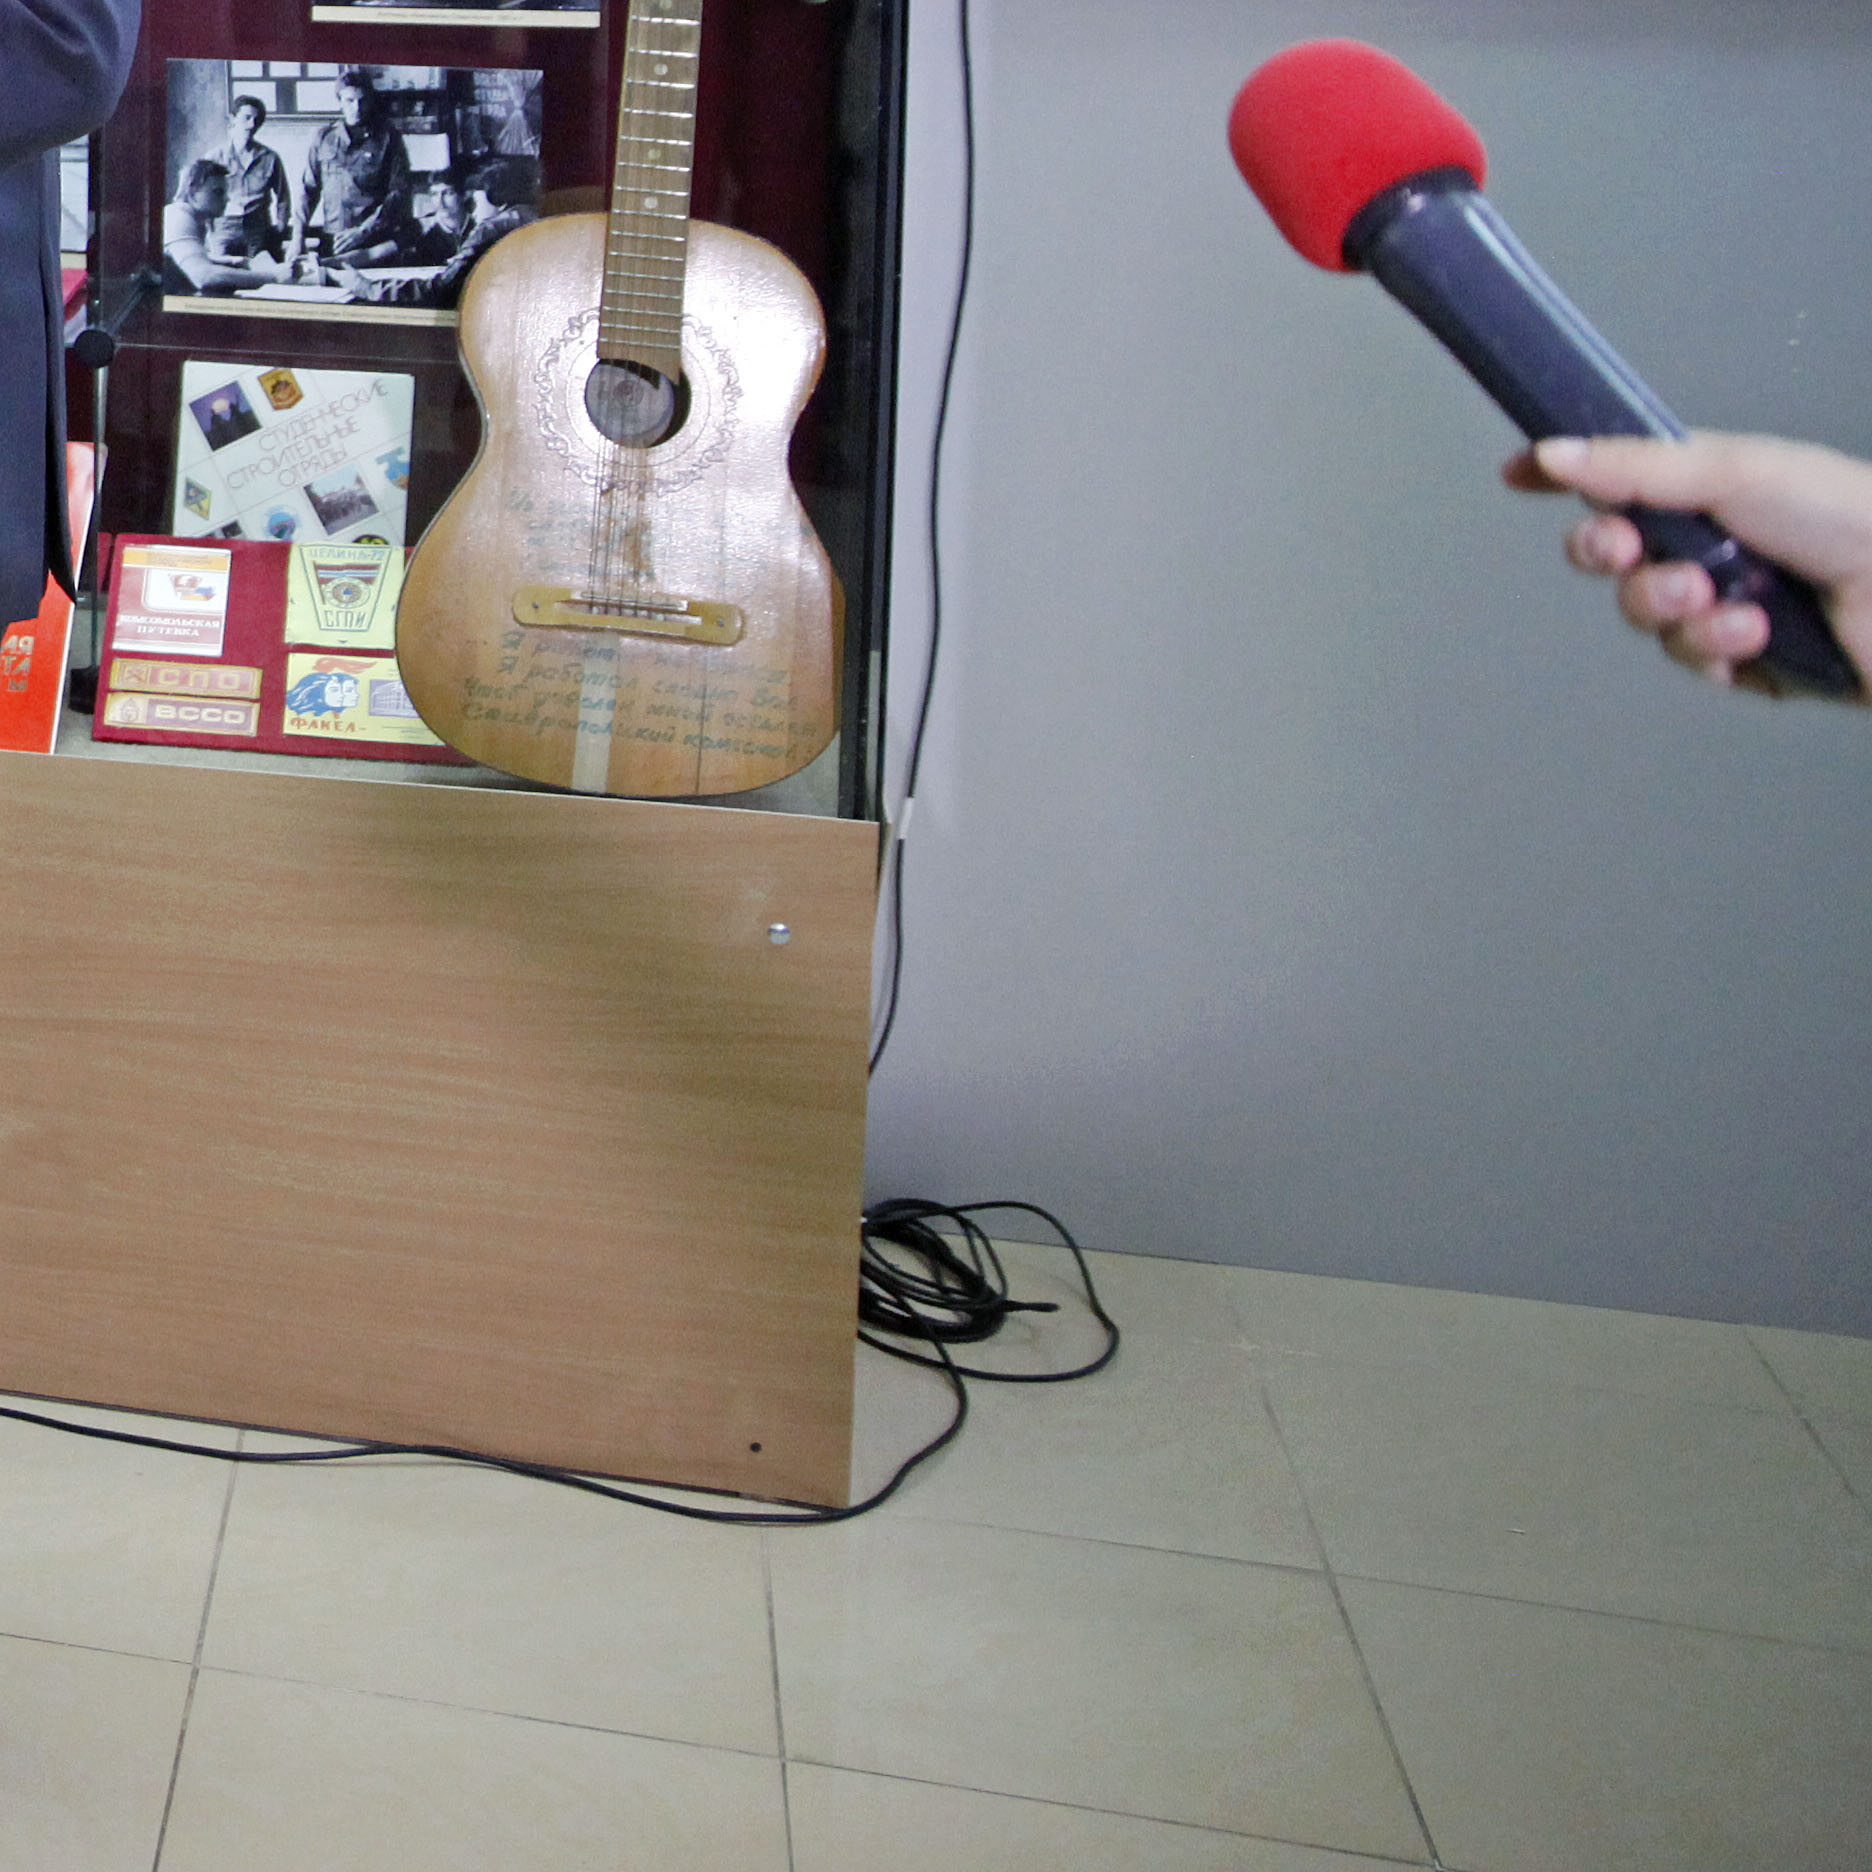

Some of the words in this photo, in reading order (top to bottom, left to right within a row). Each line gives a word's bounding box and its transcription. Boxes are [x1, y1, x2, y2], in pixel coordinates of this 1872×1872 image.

[257, 378, 389, 452] СТУДЕНЧЕСКИЕ
[226, 418, 361, 489] СТРОИТЕЛЬНЫЕ
[278, 447, 348, 488] ОТРЯДЫ
[157, 665, 241, 689] СПО
[154, 705, 246, 726] ВССО
